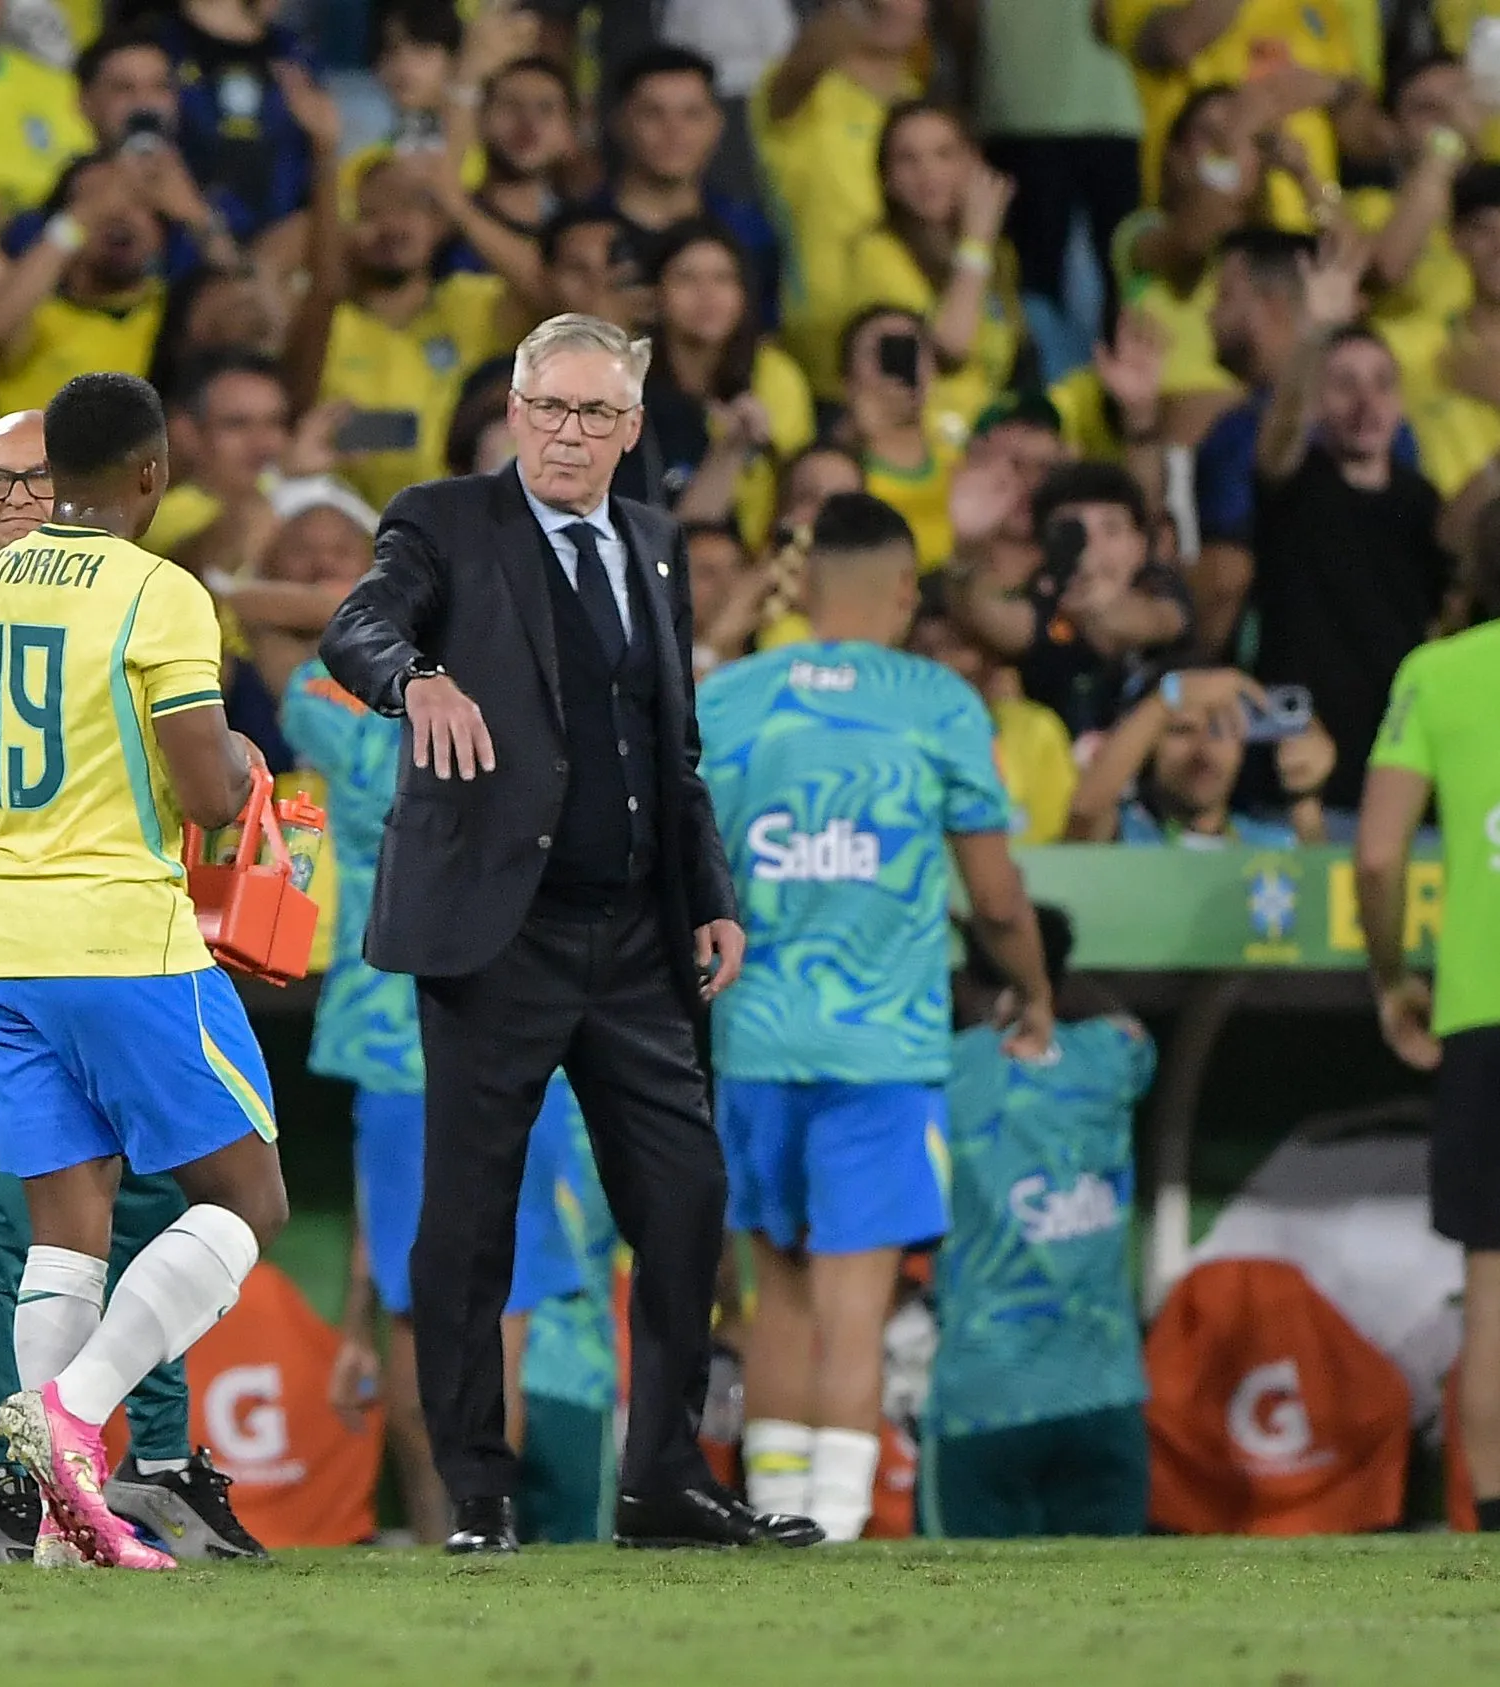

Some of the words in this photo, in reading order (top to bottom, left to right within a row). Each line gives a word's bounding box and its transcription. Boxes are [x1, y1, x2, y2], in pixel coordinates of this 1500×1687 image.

[748, 812, 880, 881] Sadia
[204, 1365, 288, 1461] G
[1226, 1358, 1313, 1457] G
